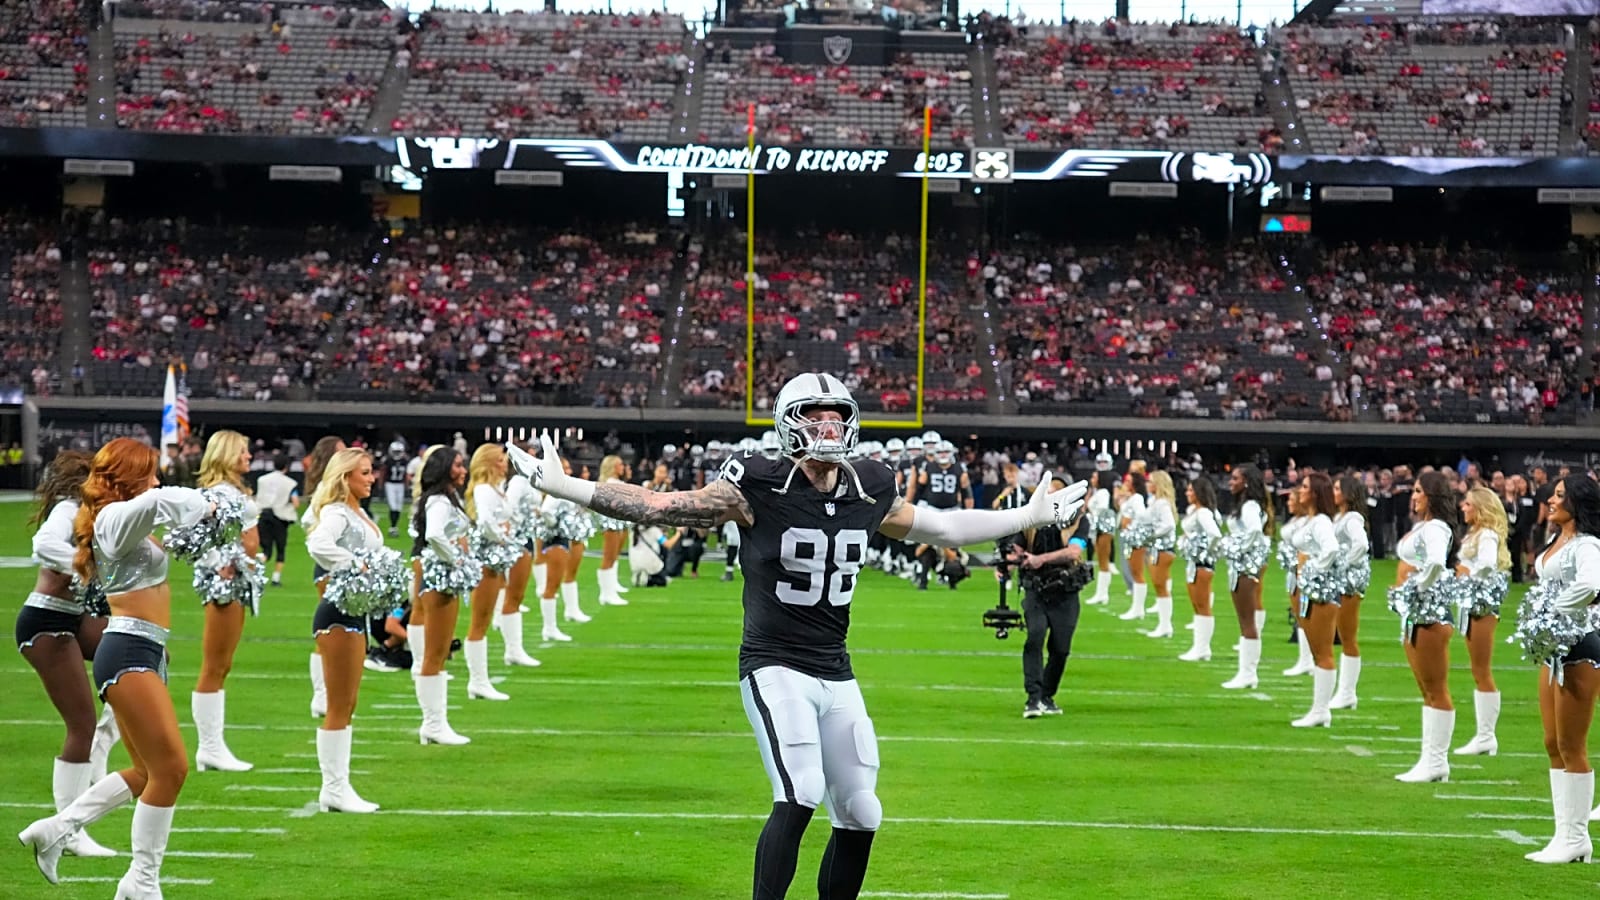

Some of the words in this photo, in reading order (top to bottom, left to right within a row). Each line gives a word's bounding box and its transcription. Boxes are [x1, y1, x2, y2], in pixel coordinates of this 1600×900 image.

[638, 143, 762, 168] COUNTDOWN
[766, 147, 791, 171] TO
[795, 149, 889, 172] KICKOFF
[914, 152, 964, 172] 8:05
[975, 151, 1009, 178] 25
[930, 473, 957, 493] 58
[775, 526, 868, 606] 98
